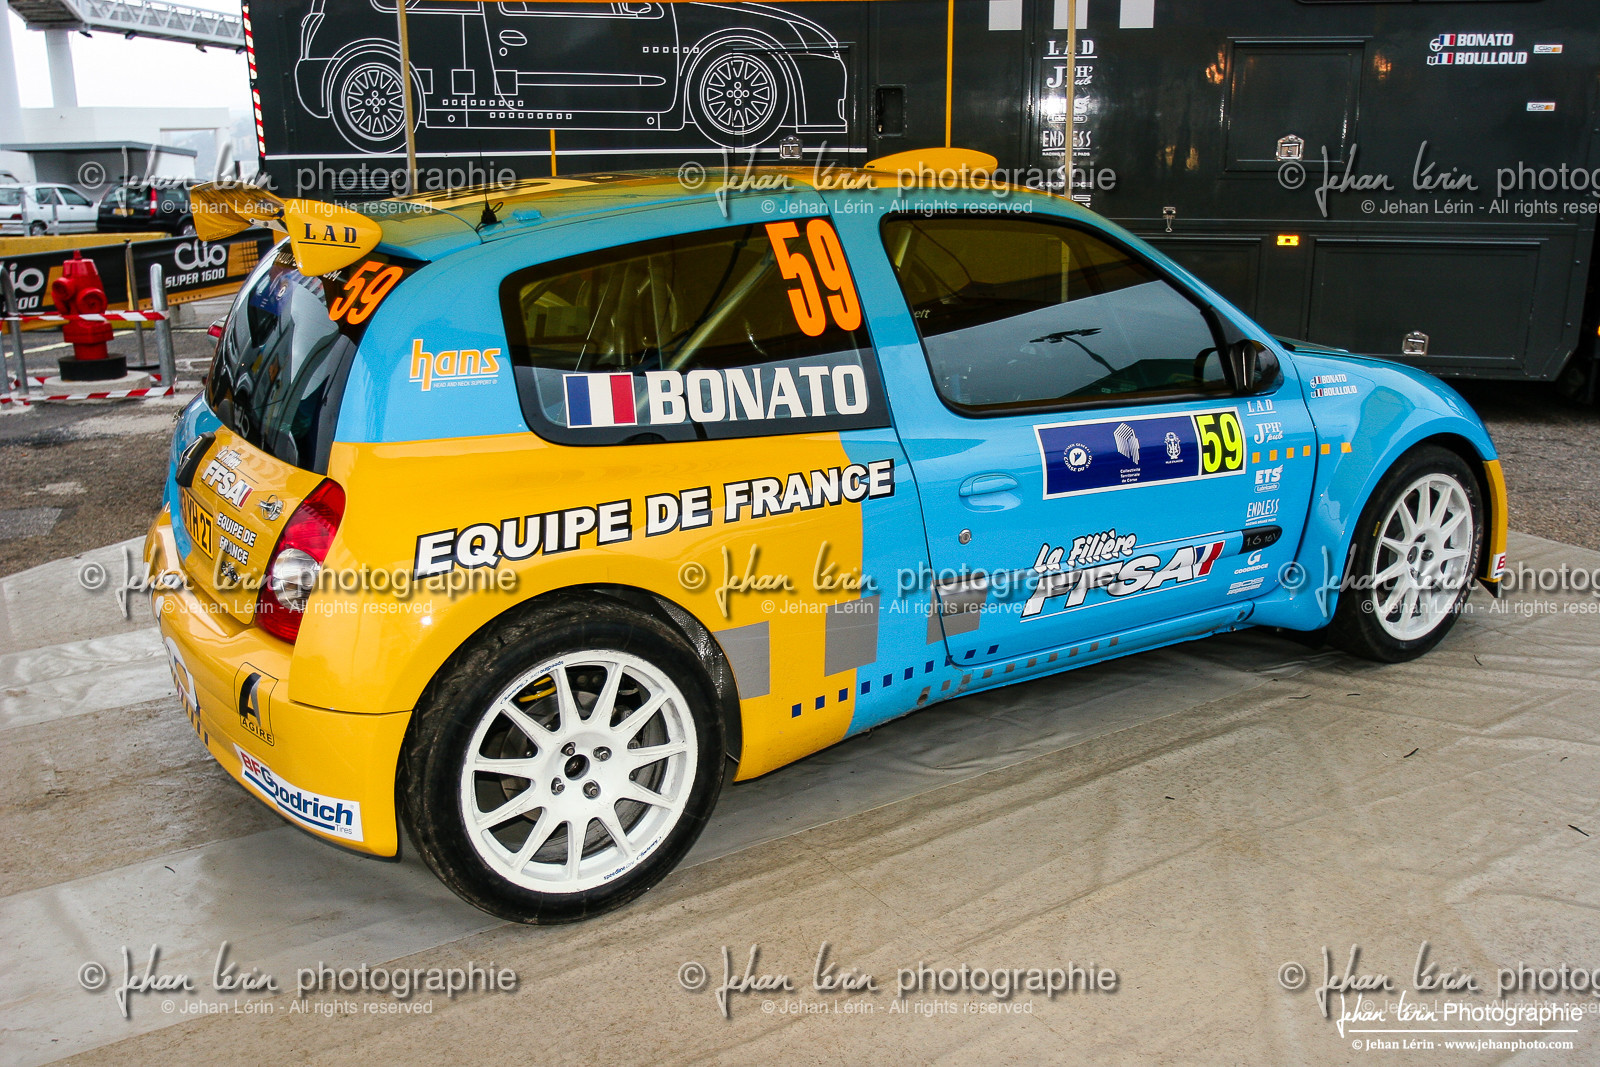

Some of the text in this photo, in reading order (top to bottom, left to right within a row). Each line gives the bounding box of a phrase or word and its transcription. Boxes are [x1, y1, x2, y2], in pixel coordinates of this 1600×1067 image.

[1457, 33, 1513, 46] BONATO
[1455, 52, 1527, 65] BOULLOUD
[1042, 130, 1092, 147] ENDESS
[174, 239, 227, 271] Clio
[165, 267, 225, 289] SUPER 1600
[329, 260, 403, 325] 59
[765, 219, 861, 336] 59
[409, 339, 501, 392] hans
[1321, 374, 1347, 384] BONATO
[645, 364, 869, 425] BONATO
[1323, 385, 1357, 397] BOULLOUD
[1196, 413, 1243, 473] 59
[201, 459, 247, 507] FFSA
[1254, 464, 1284, 485] ETS
[413, 457, 895, 581] EQUIPE DE FRANCE
[1246, 498, 1280, 518] ENDLESS
[200, 513, 213, 556] 27
[217, 511, 258, 548] EQUIPE DE
[219, 535, 250, 567] FRANCE
[1033, 528, 1137, 573] La Filière
[1020, 545, 1196, 618] FFSA
[241, 718, 273, 744] AGIRE
[240, 750, 353, 826] BFGoodrich
[335, 824, 353, 835] Tires
